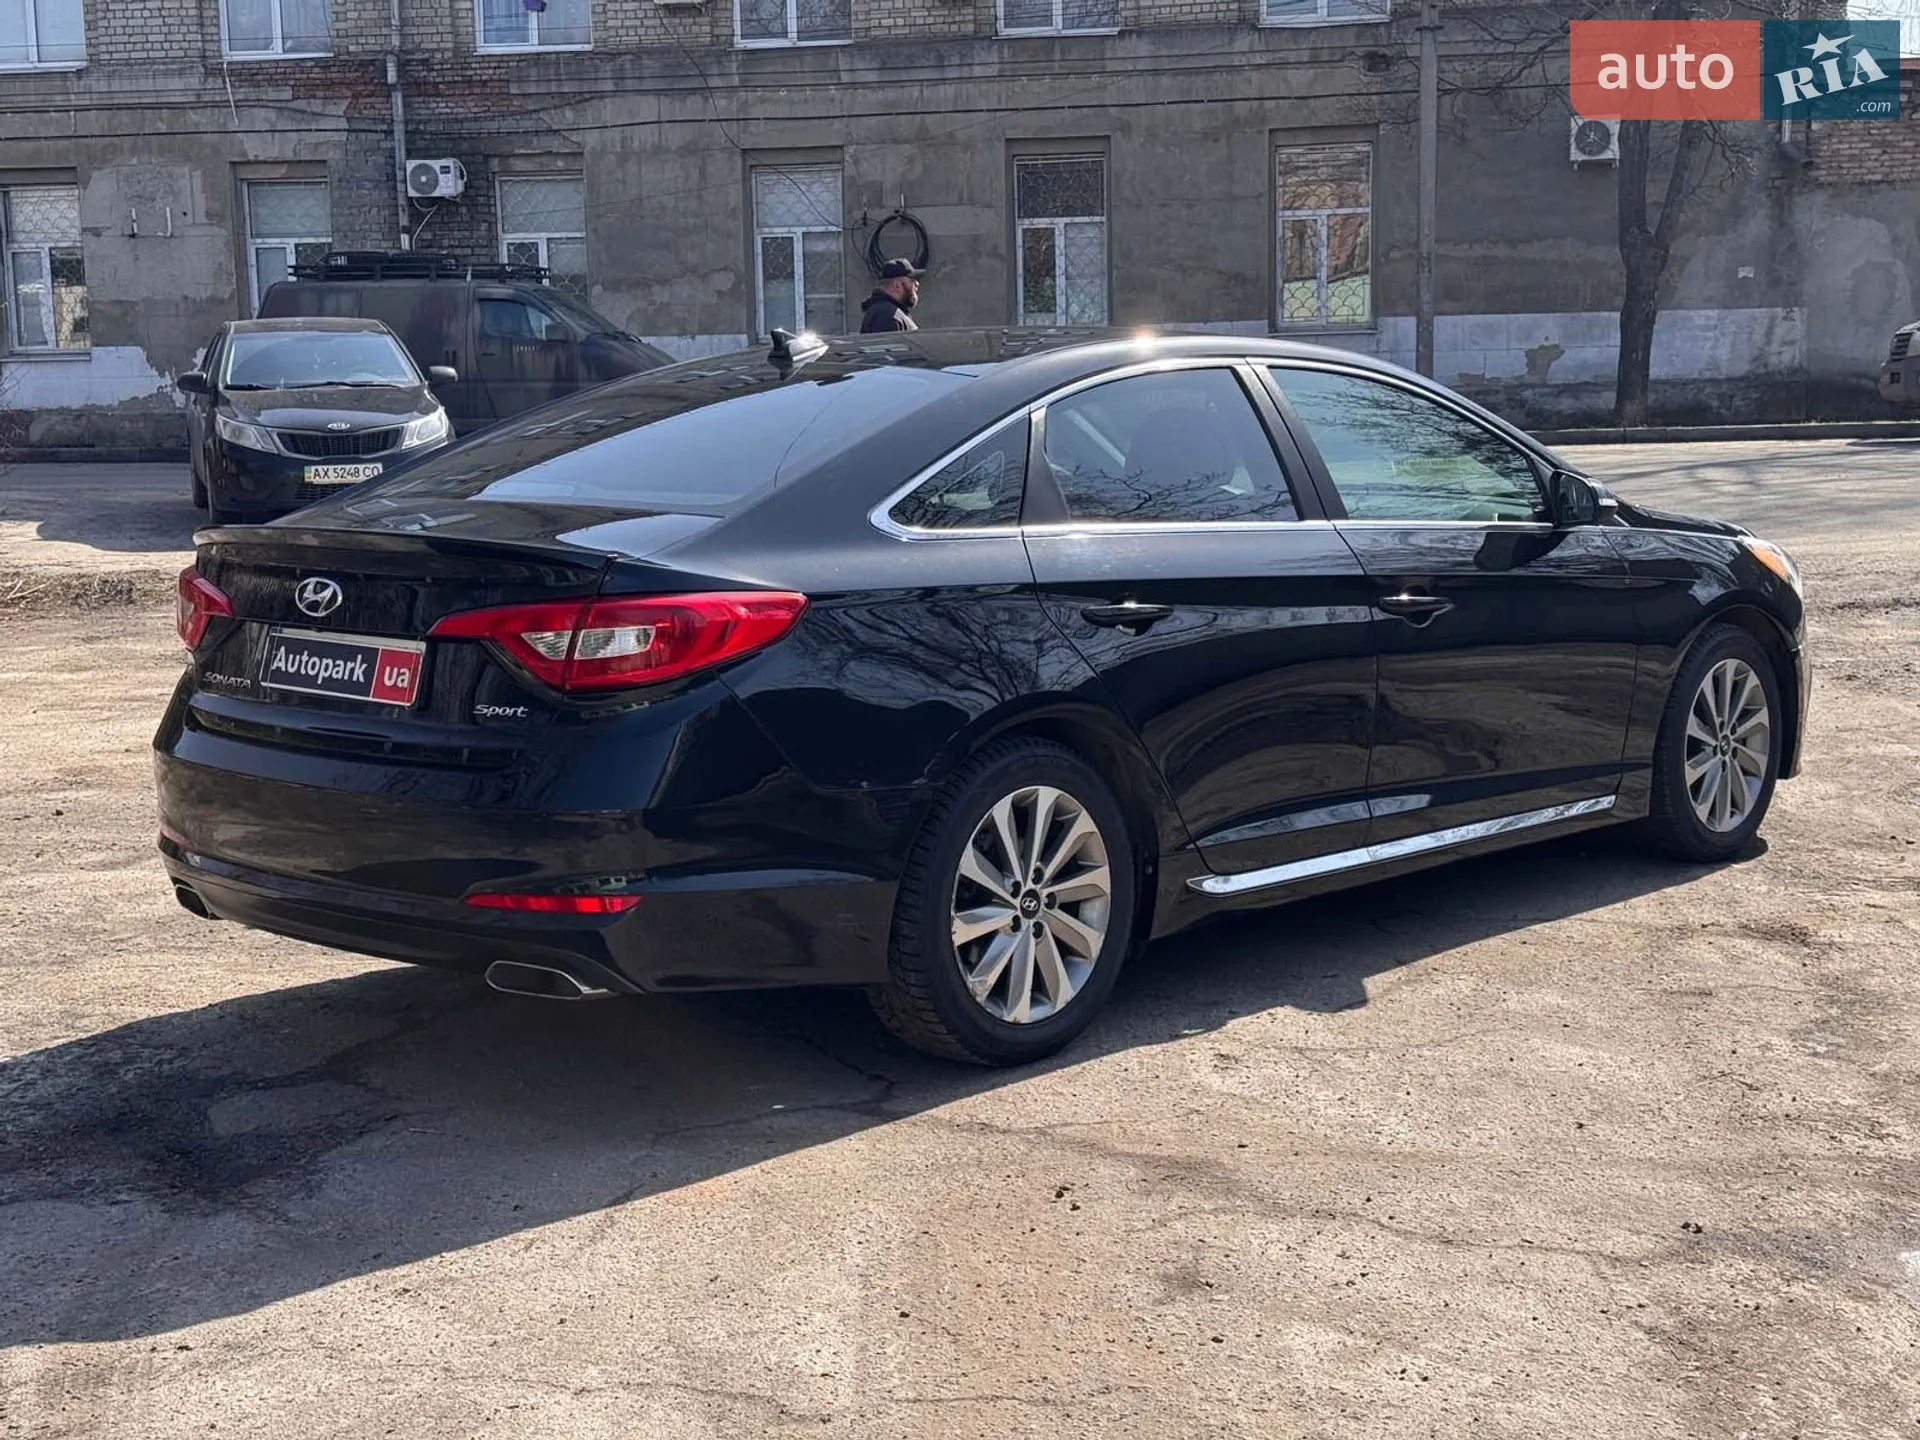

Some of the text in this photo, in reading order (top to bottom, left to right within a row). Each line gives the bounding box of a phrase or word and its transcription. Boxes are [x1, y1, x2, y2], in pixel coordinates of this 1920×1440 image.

[312, 468, 331, 480] AX
[333, 467, 360, 479] 5248
[270, 645, 411, 689] Autopark ua
[202, 670, 252, 690] SONATA
[473, 703, 529, 718] Sport
